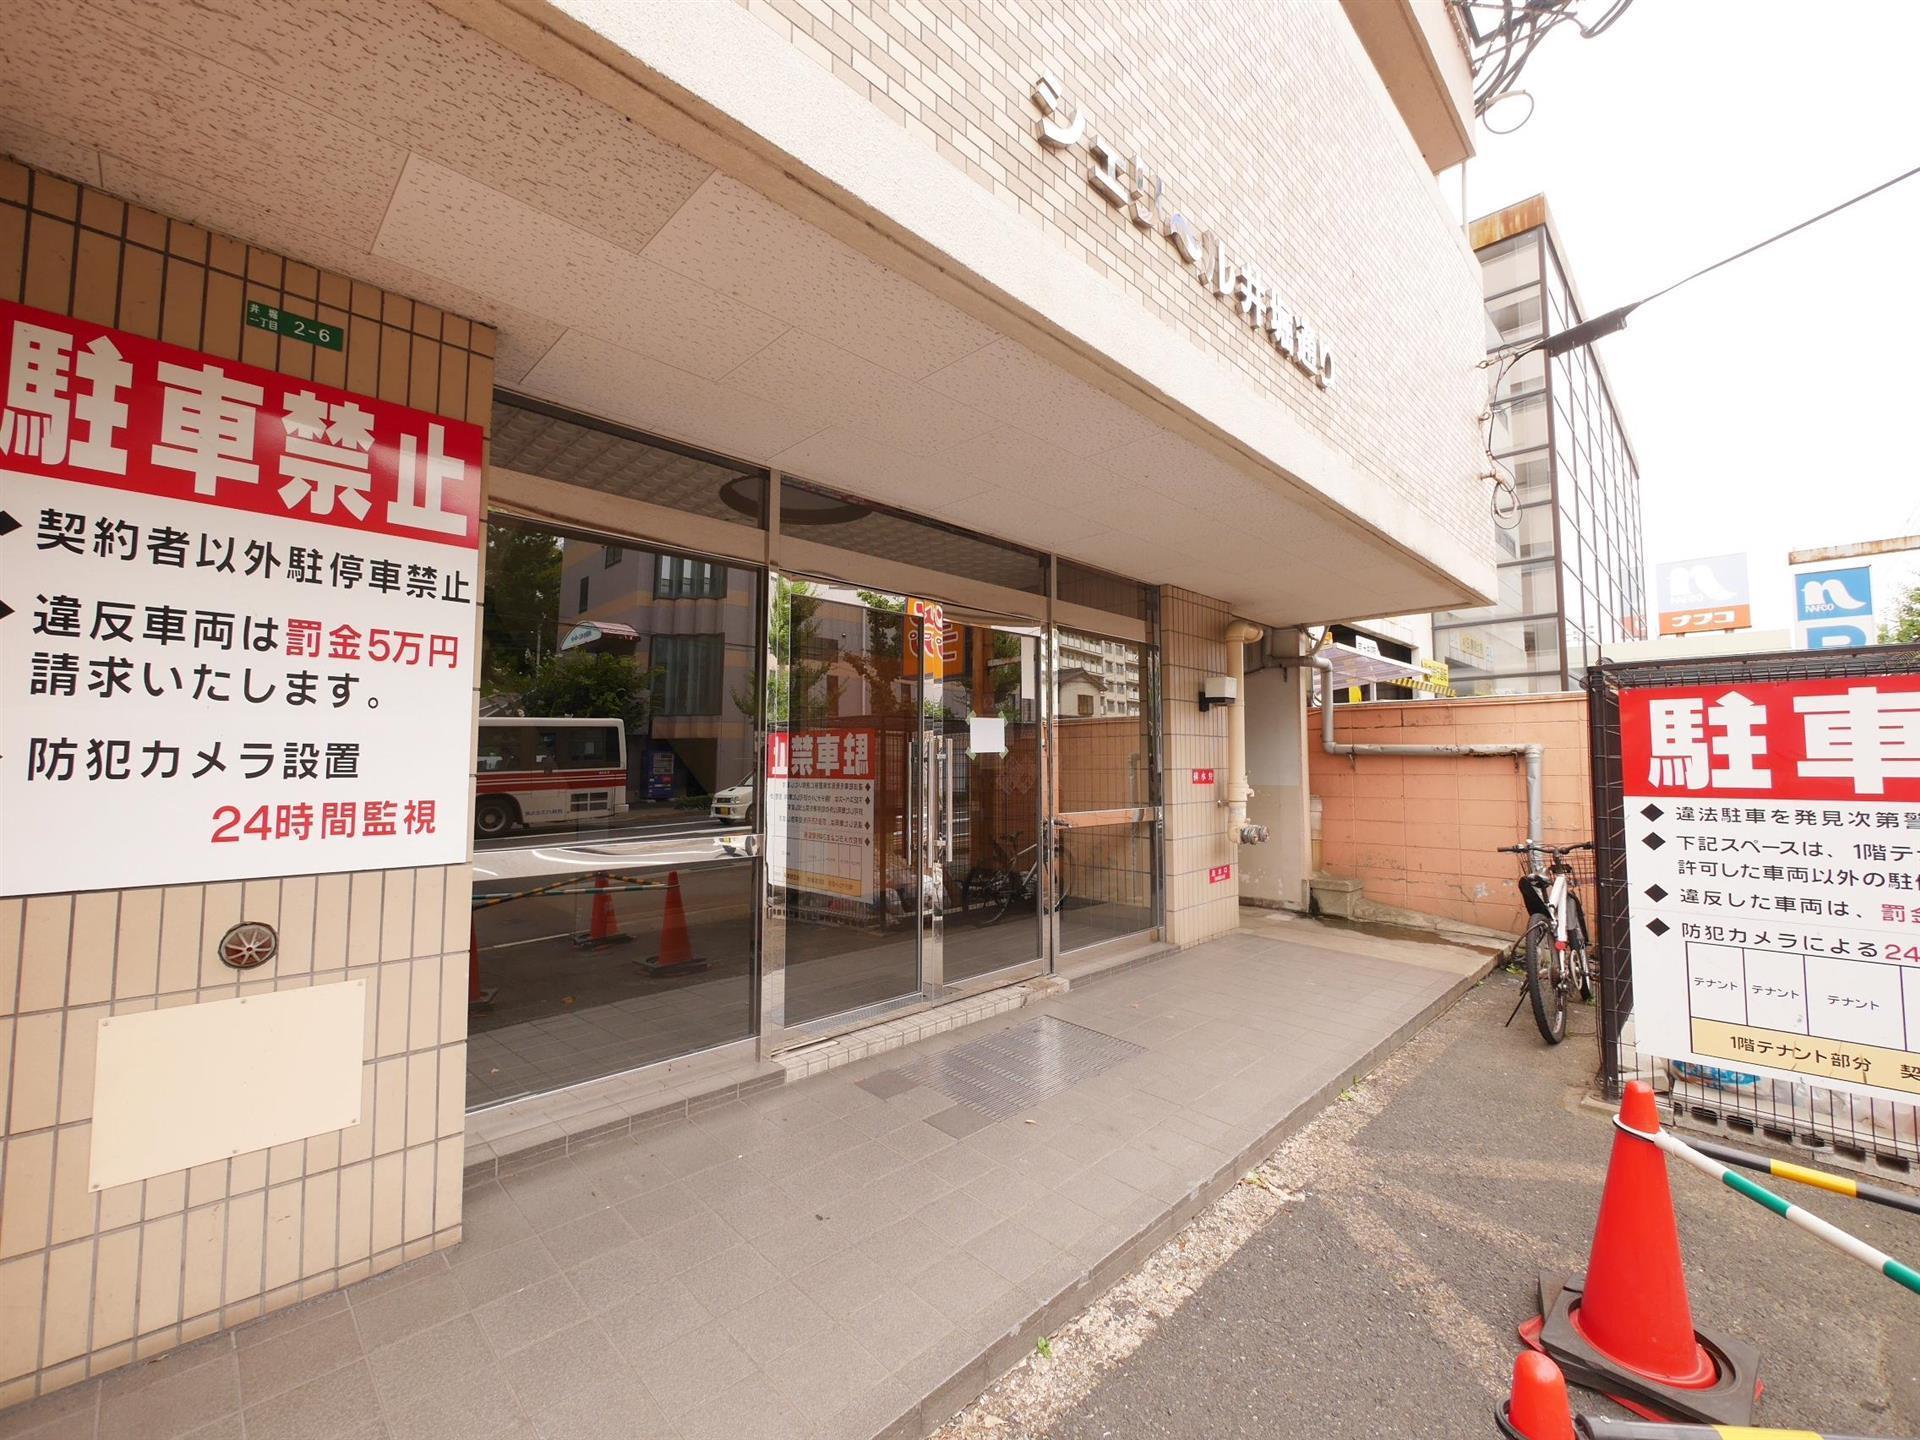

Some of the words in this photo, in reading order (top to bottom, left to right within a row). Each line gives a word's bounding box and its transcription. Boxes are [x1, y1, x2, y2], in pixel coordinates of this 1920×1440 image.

[294, 321, 330, 342] 2-6
[0, 320, 468, 537] 駐車禁止
[36, 508, 470, 604] 契約者以外駐停車禁止
[33, 594, 459, 669] 違反車両は罰金5万円
[30, 652, 380, 710] 請求いたします。
[27, 737, 360, 782] 防犯カメラ設置
[1648, 686, 1920, 795] 駐車
[211, 800, 436, 844] 24時間監視
[1676, 834, 1920, 862] 下記スペースは、1階テ
[1678, 859, 1920, 890] 許可した車両以外の駐
[1694, 977, 1738, 991] テナント
[1752, 985, 1800, 1000] テナント
[1828, 995, 1880, 1011] テナント
[1729, 1036, 1872, 1073] 1階テナント部分
